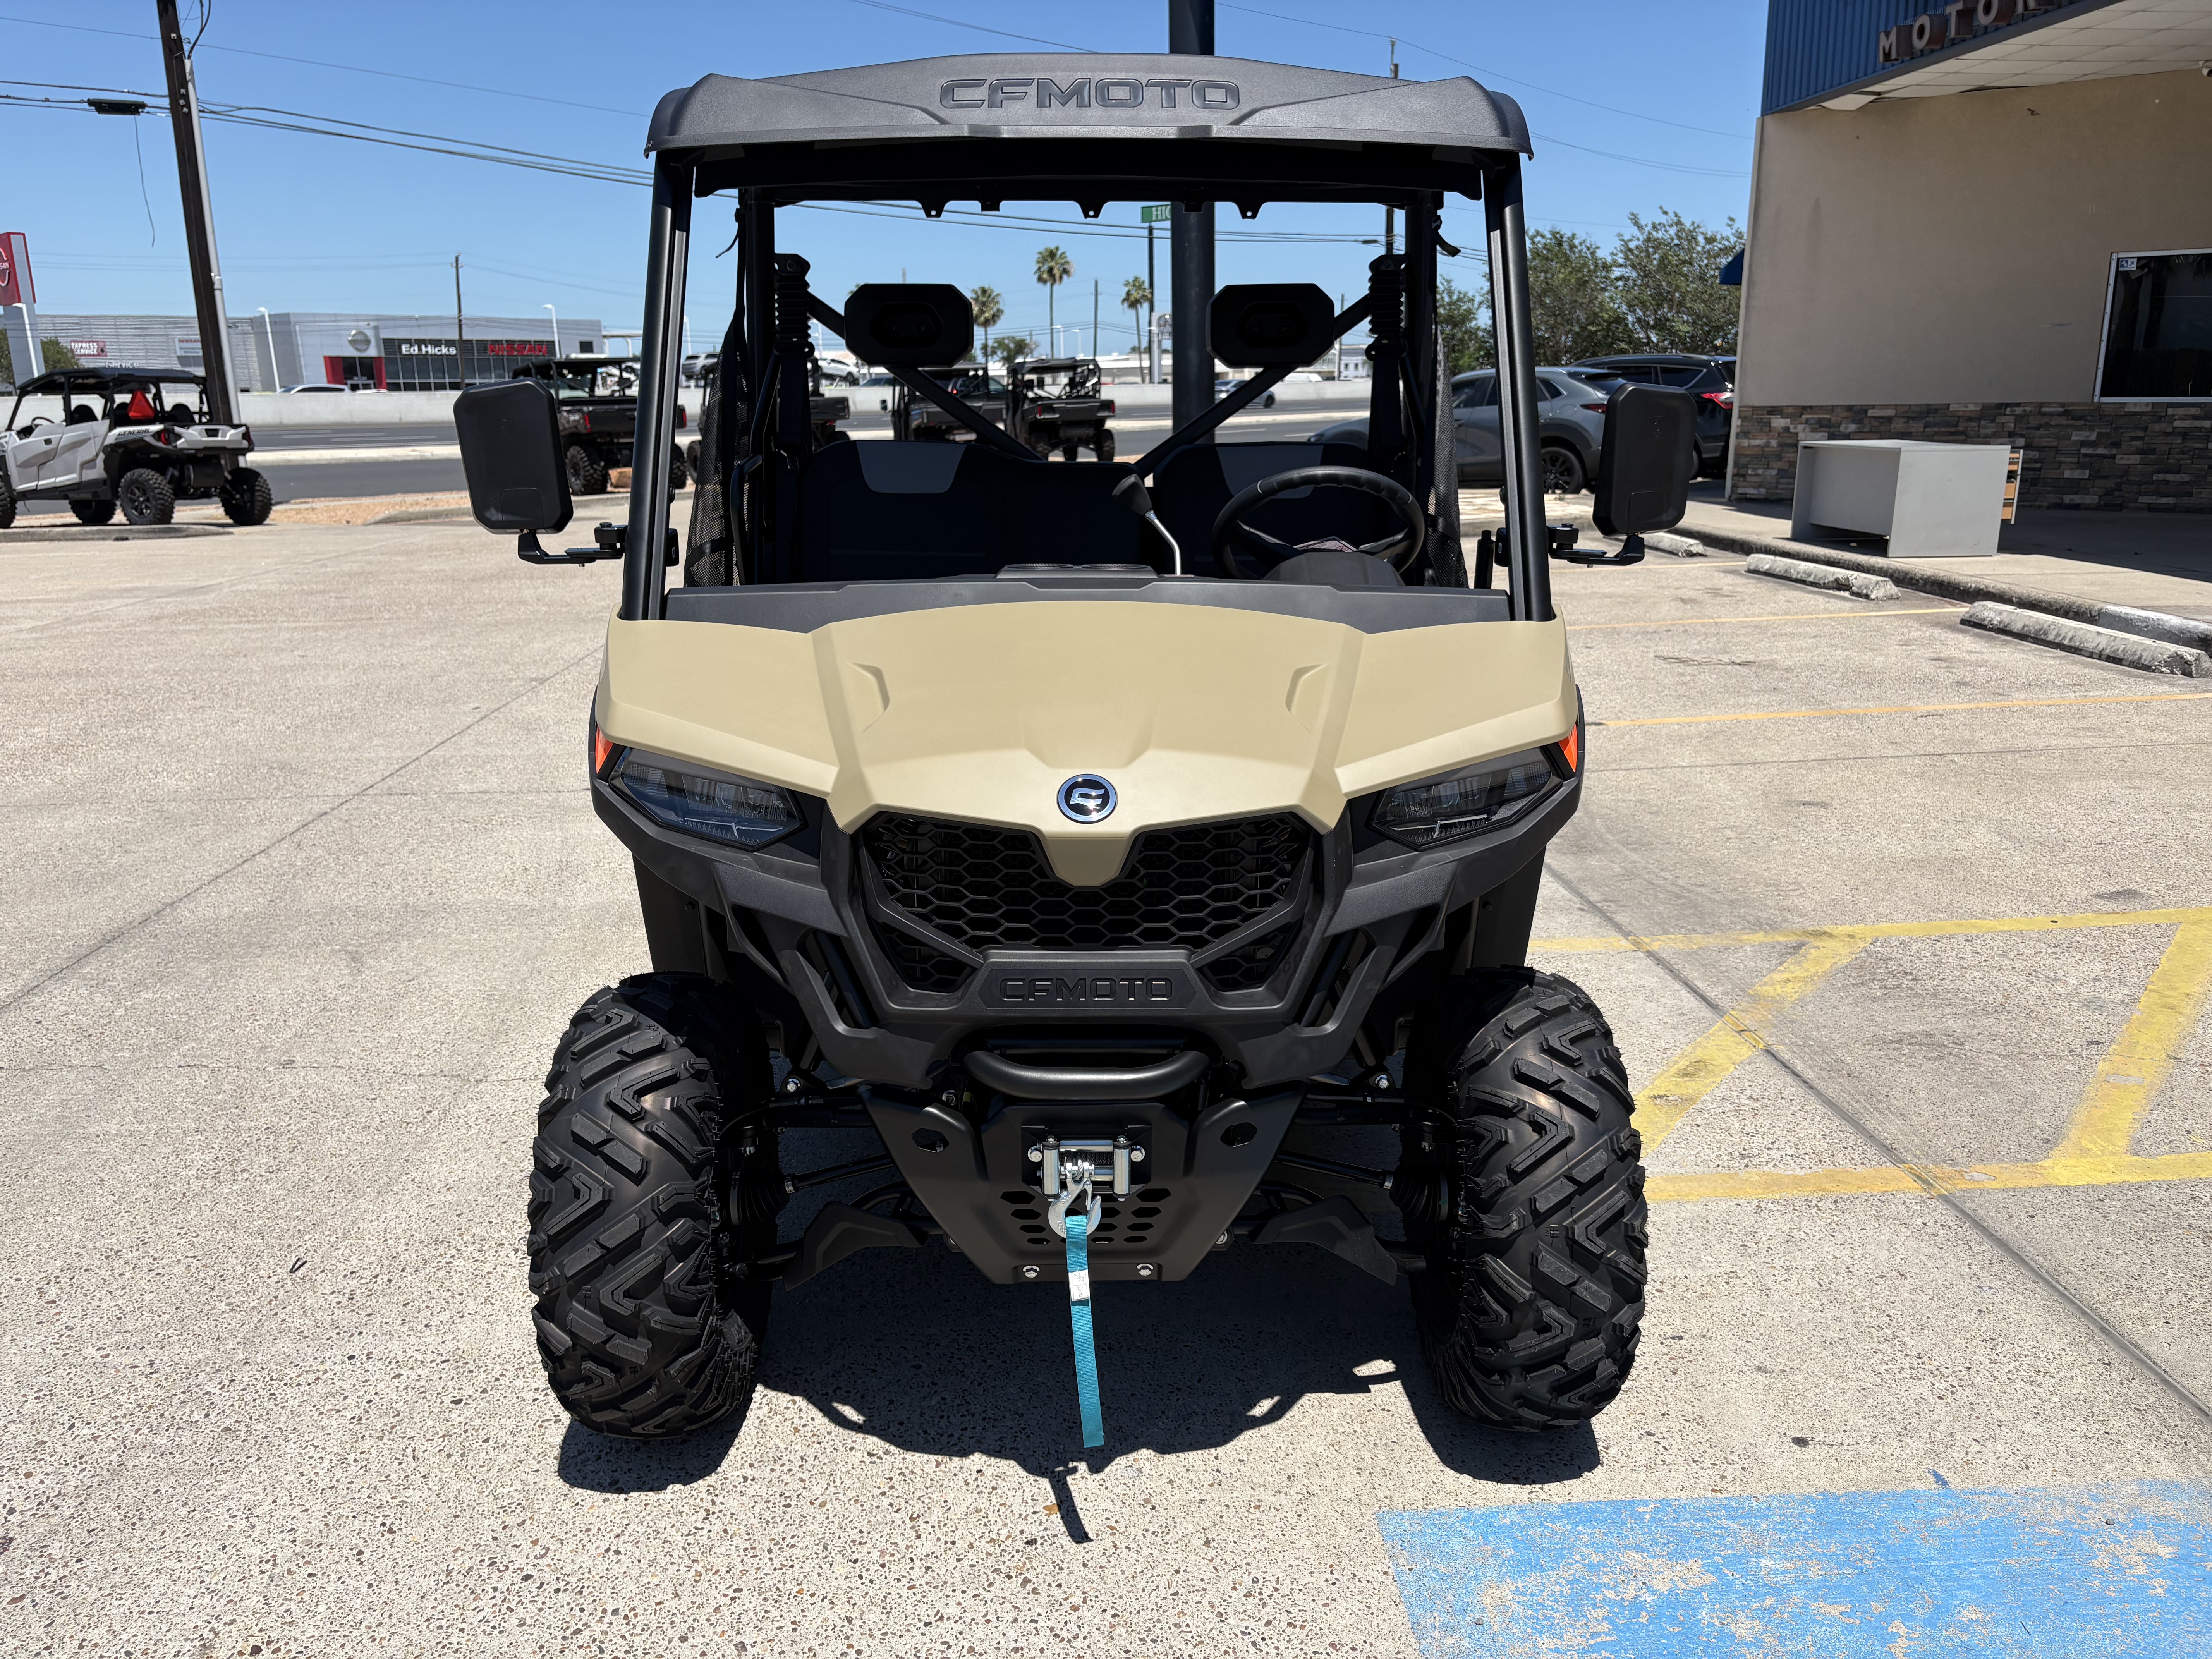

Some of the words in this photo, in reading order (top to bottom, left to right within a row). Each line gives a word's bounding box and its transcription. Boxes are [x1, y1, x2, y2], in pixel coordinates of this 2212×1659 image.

[940, 77, 1240, 110] CFMOTO
[401, 344, 418, 355] Ed
[421, 344, 457, 355] Hicks
[489, 343, 548, 356] NISSAN
[1000, 977, 1173, 1001] CFMOTO
